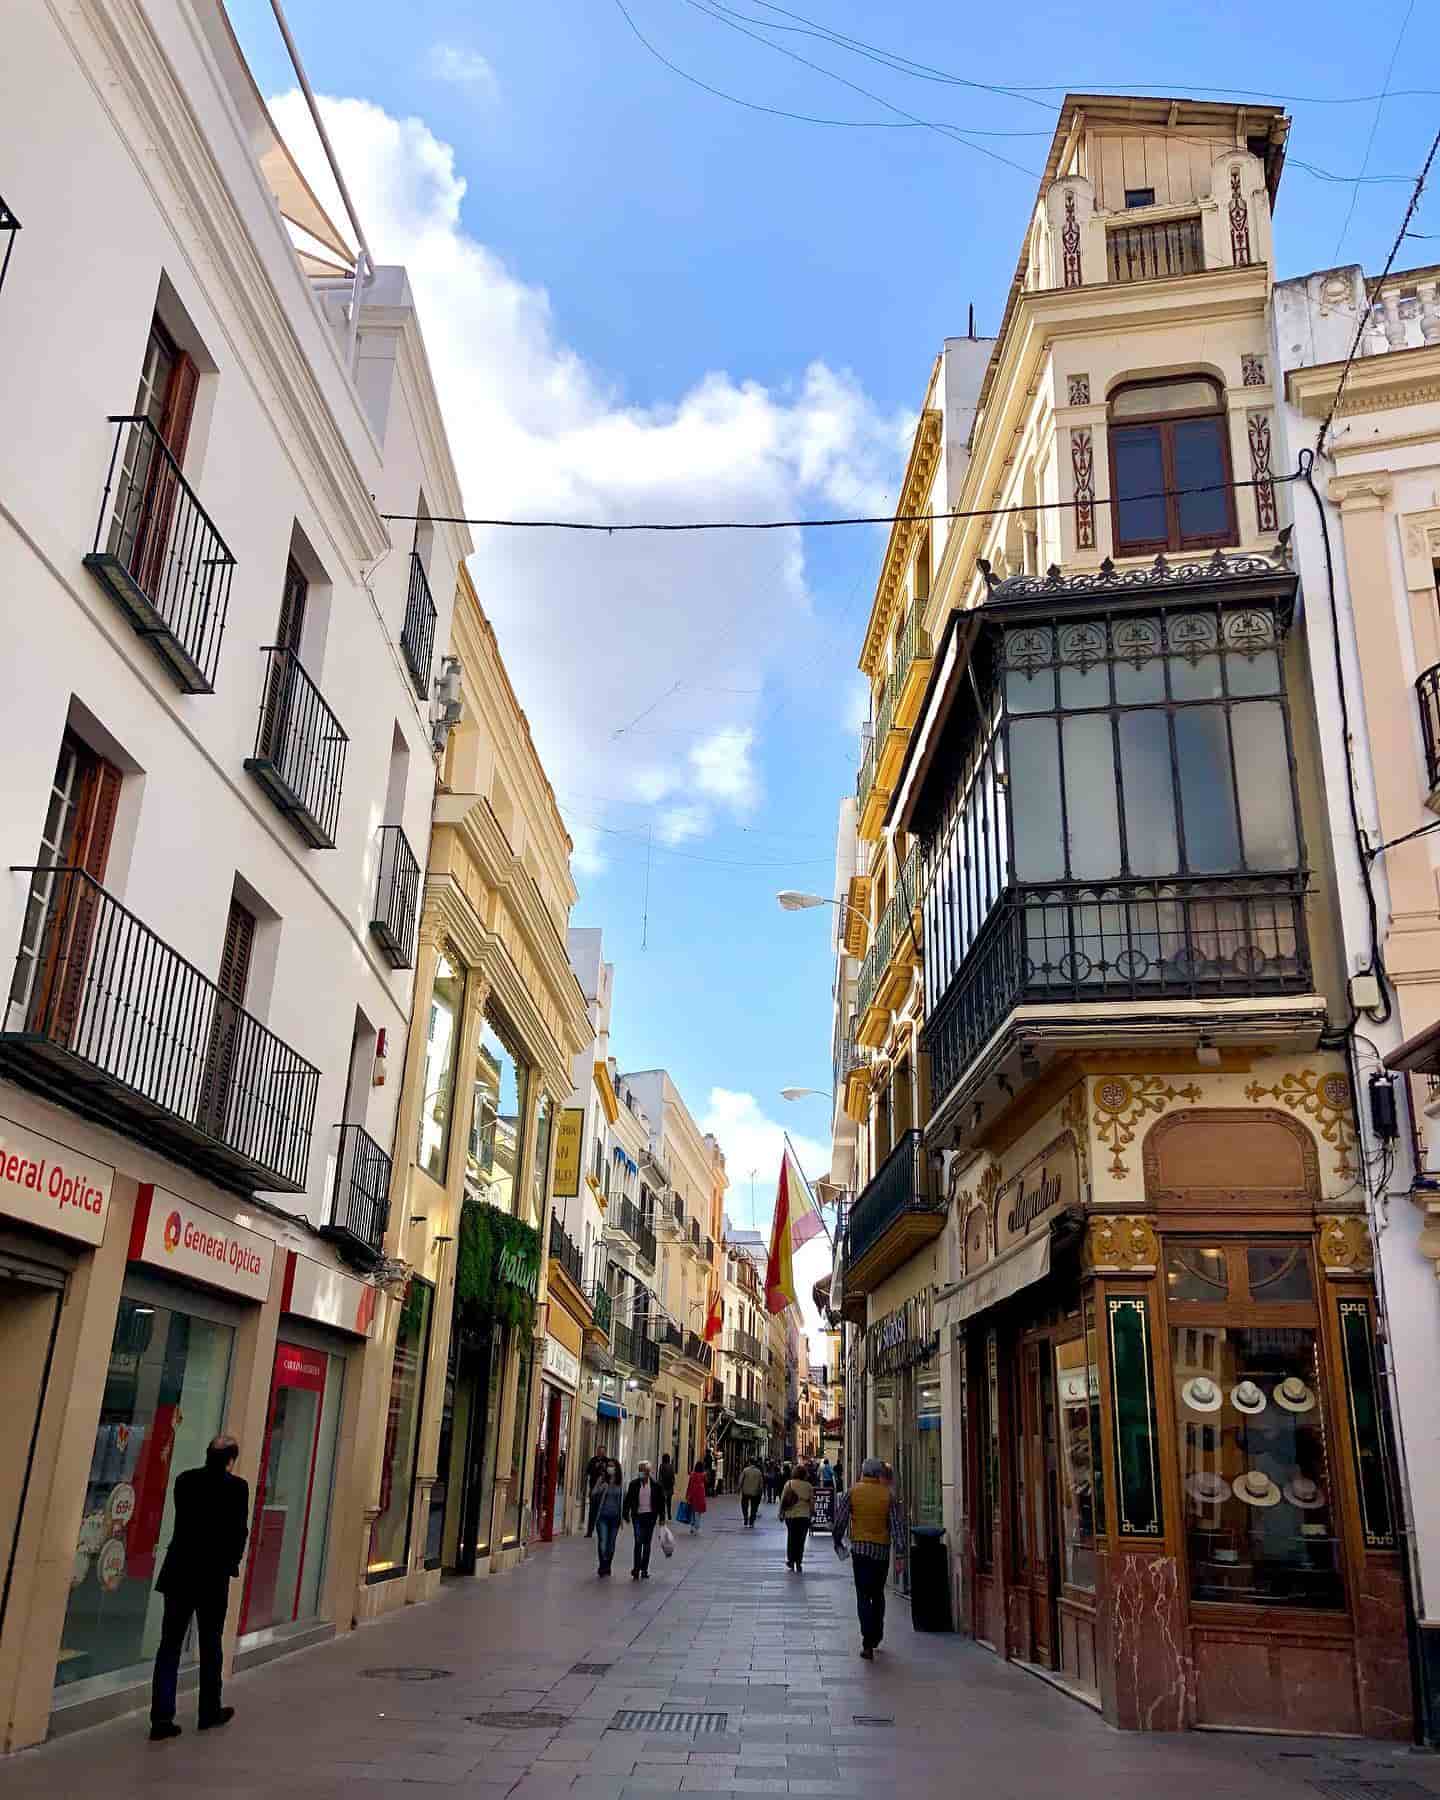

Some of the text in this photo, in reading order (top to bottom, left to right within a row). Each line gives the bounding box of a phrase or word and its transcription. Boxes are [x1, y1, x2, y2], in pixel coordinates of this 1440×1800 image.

[48, 1165, 103, 1215] Optica
[184, 1221, 262, 1276] General Optica
